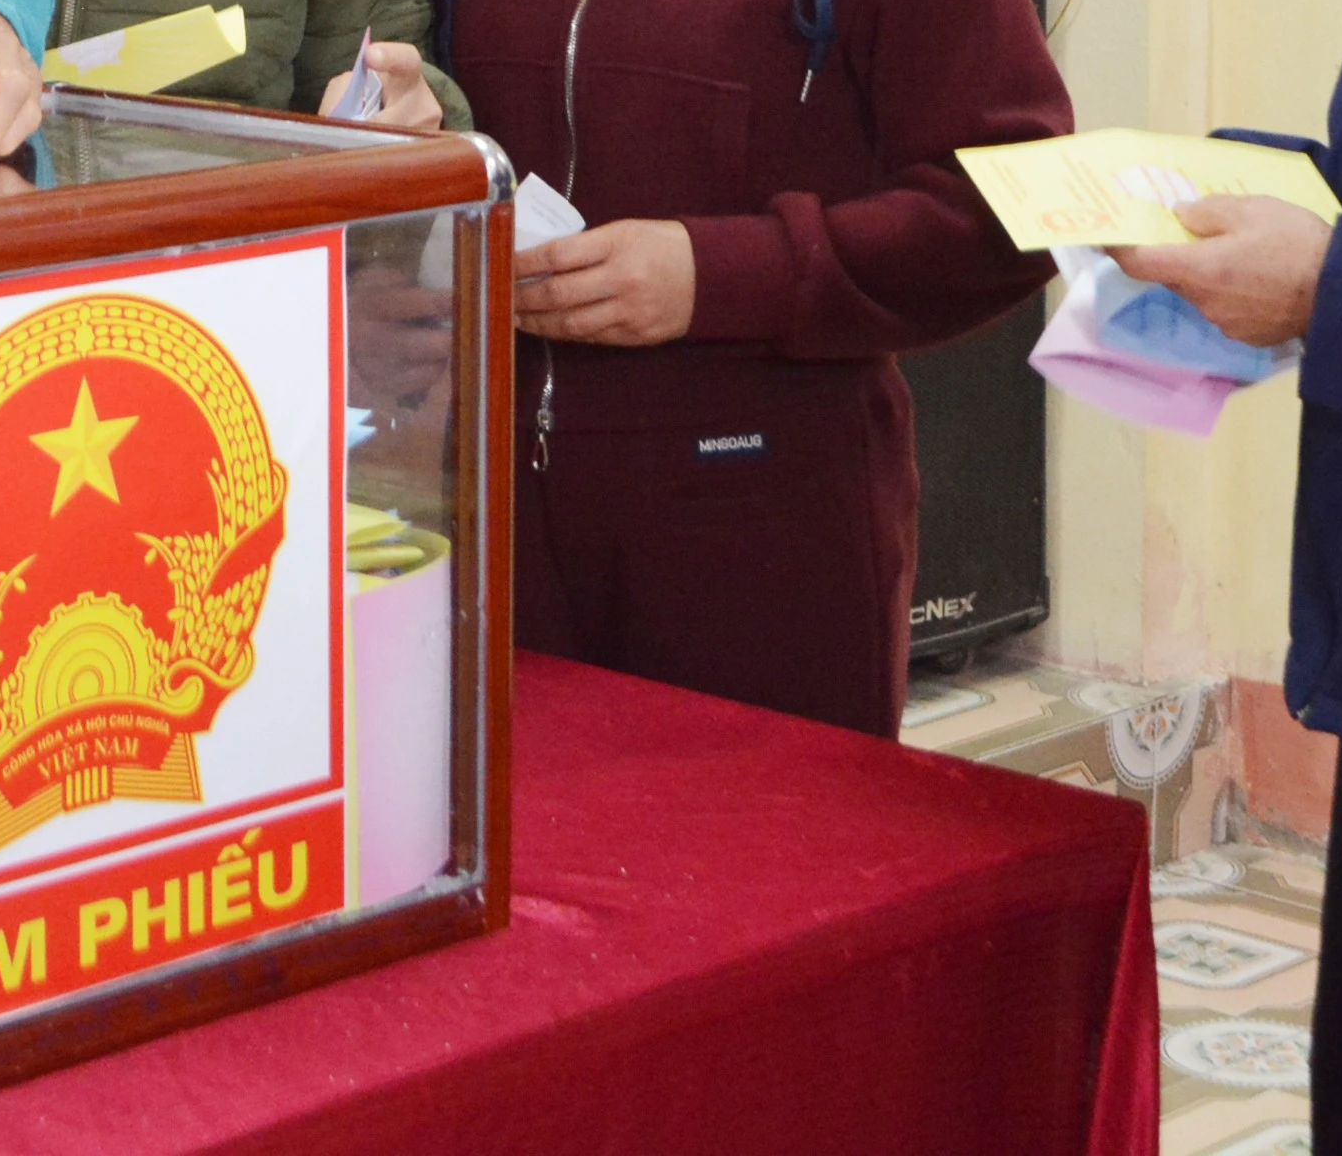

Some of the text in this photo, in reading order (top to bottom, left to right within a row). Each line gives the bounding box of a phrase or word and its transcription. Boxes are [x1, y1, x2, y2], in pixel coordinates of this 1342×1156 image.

[2, 745, 36, 779] CỘNG
[37, 729, 64, 752] HÒA
[66, 719, 83, 738] XÃ
[86, 714, 106, 733] HỘI
[109, 710, 134, 728] CHỦ
[38, 735, 139, 780] VIỆT NAM
[79, 826, 308, 969] PHIẾU
